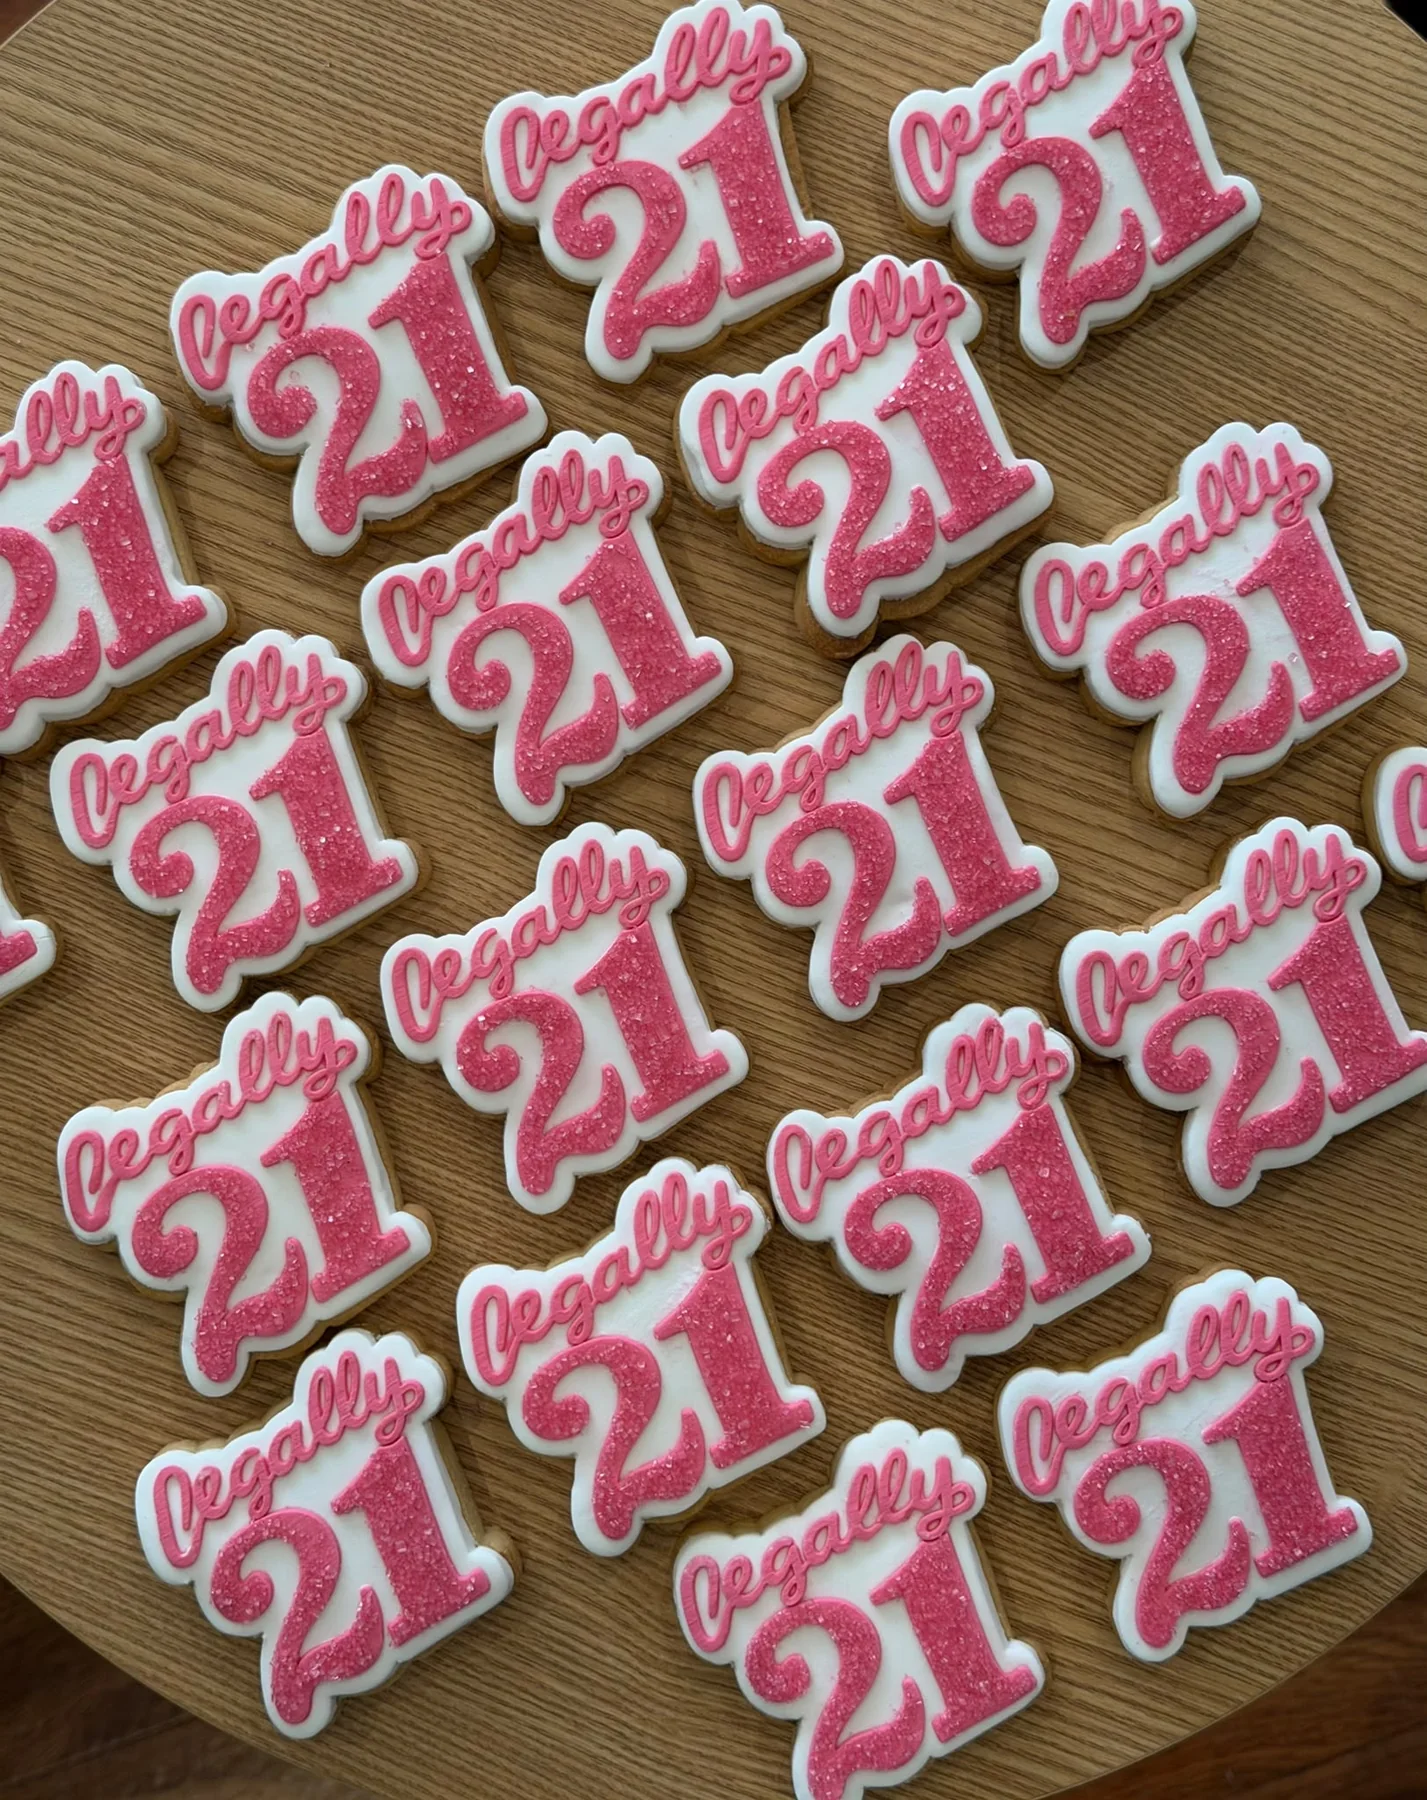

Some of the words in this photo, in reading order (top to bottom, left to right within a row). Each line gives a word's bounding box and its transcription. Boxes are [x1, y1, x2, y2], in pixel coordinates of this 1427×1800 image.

[554, 101, 835, 361] 21
[972, 57, 1247, 346] 21
[248, 251, 529, 536] 21
[758, 340, 1036, 620] 21
[448, 532, 722, 807] 21
[1107, 519, 1401, 796] 21
[131, 727, 403, 995] 21
[766, 732, 1042, 1009] 21
[457, 921, 730, 1197] 21
[1143, 913, 1427, 1191] 21
[133, 1090, 411, 1384] 21
[845, 1104, 1136, 1373] 21
[523, 1267, 815, 1541] 21
[1075, 1377, 1358, 1649] 21
[212, 1435, 491, 1726] 21
[746, 1536, 1037, 1800] 21
